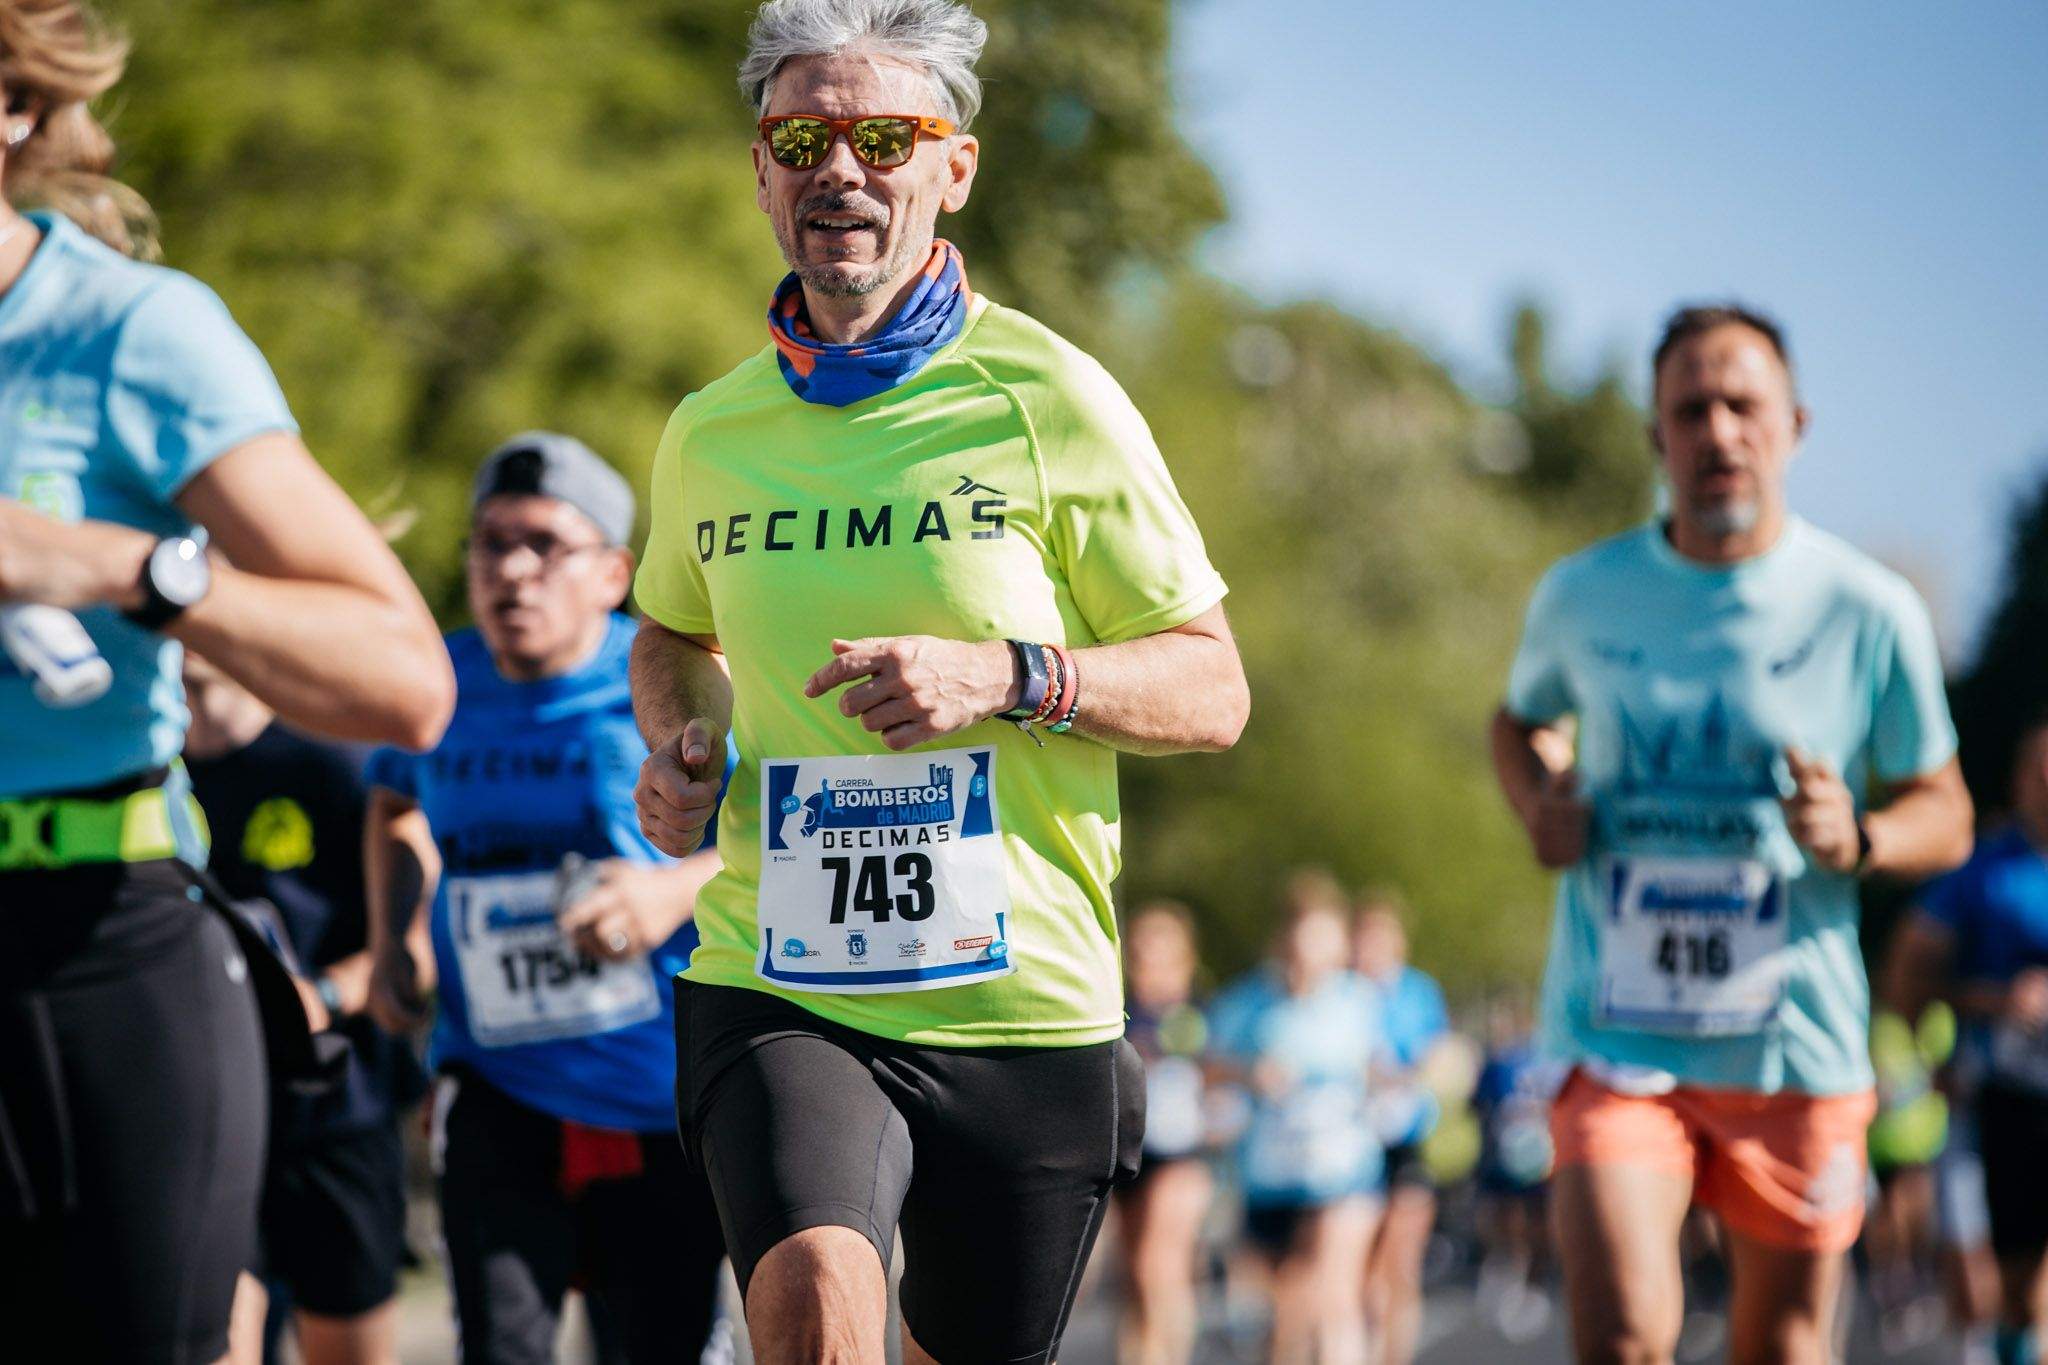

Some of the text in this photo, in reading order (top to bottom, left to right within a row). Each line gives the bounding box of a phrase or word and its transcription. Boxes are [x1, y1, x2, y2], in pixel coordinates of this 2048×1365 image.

[697, 500, 1007, 564] DECIMAS
[835, 779, 874, 788] CARRERA
[835, 785, 949, 807] BOMBEROS
[877, 802, 951, 826] de MADRID
[823, 824, 949, 849] DECIMAS
[821, 853, 935, 924] 743
[1655, 929, 1732, 979] 416
